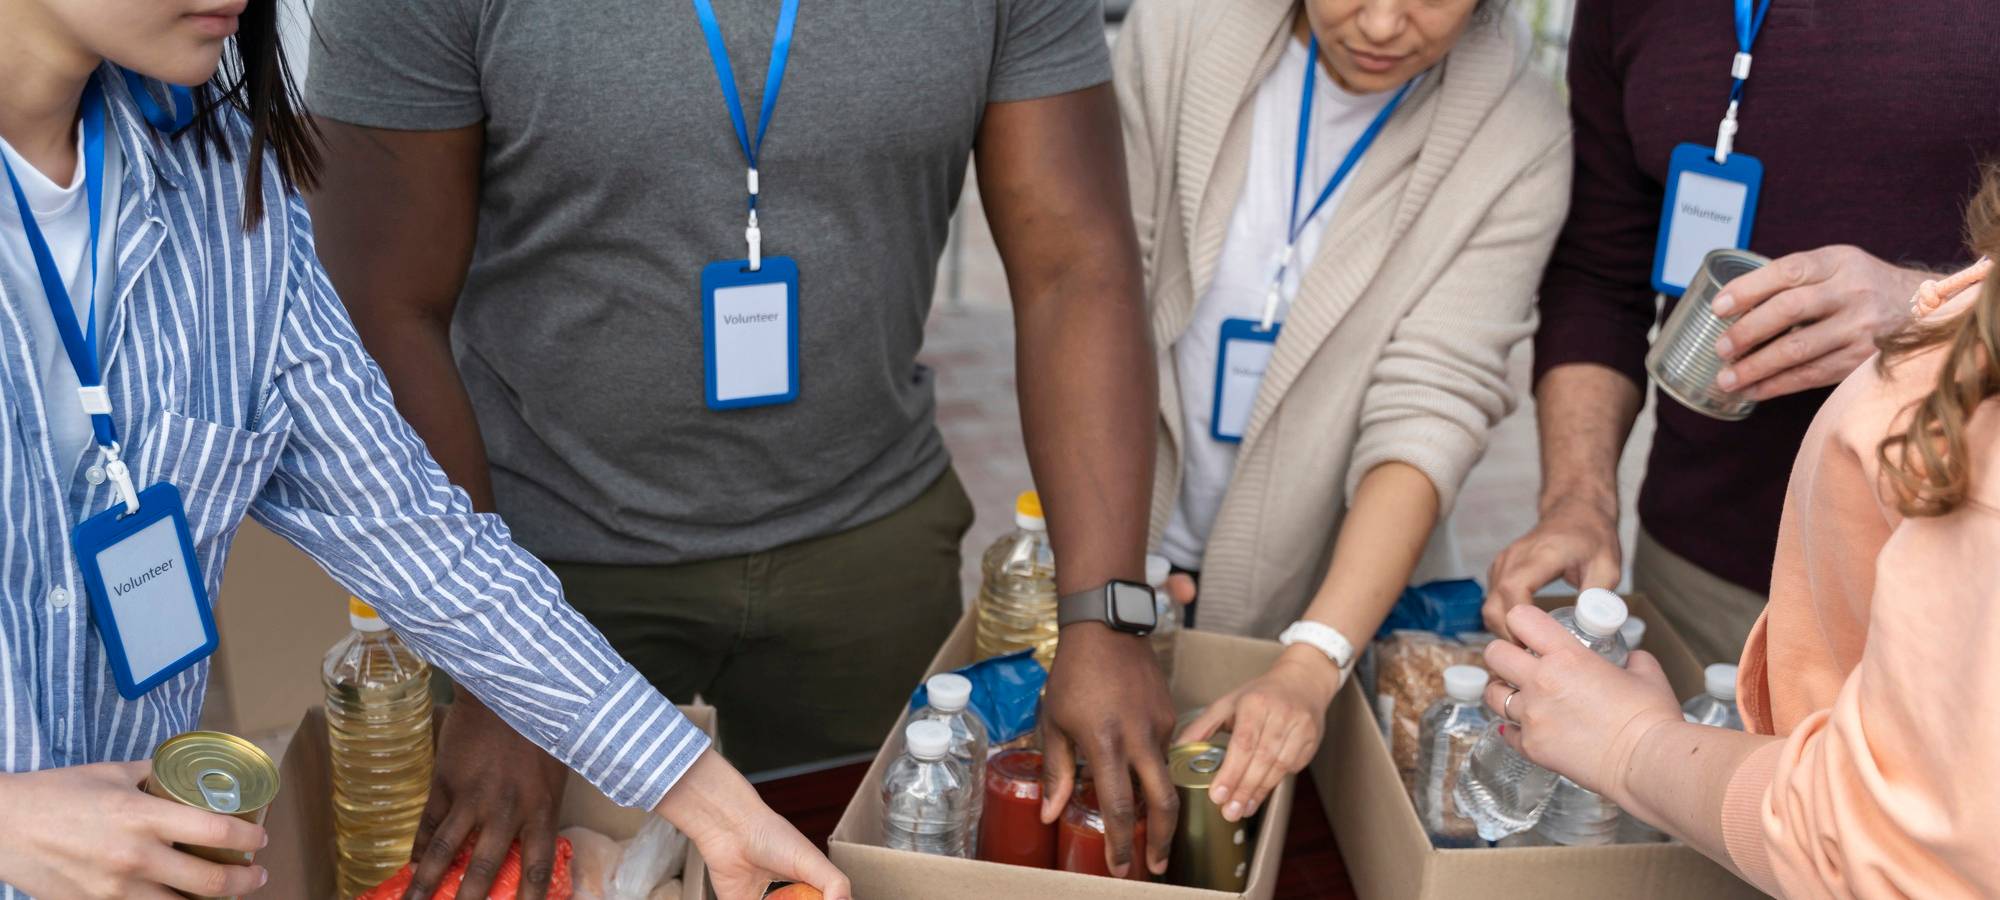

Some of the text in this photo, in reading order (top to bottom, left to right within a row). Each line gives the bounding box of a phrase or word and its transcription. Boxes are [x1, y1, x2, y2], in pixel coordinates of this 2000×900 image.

[1680, 202, 1733, 224] Volunteer
[723, 313, 778, 325] Volunteer
[113, 558, 174, 596] Volunteer
